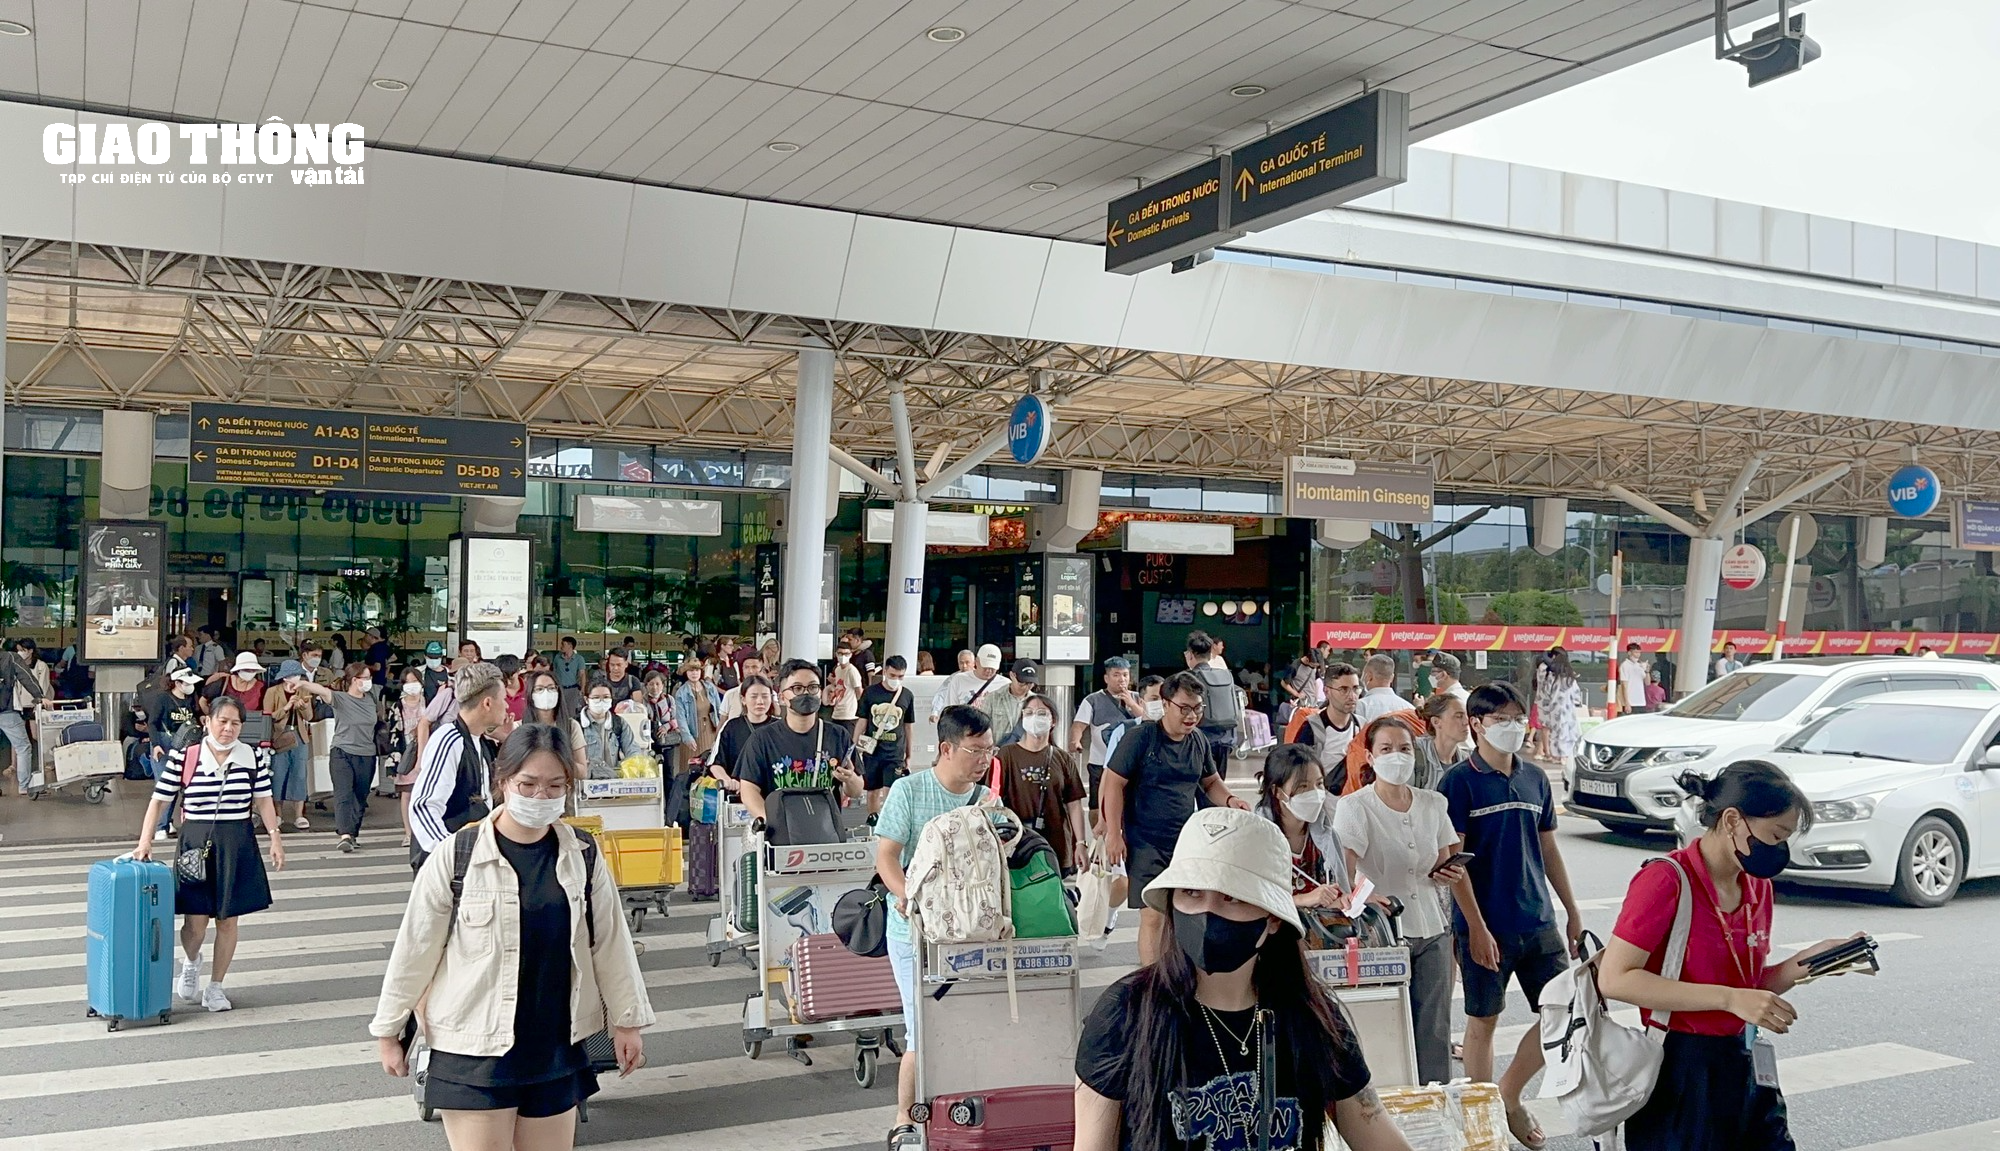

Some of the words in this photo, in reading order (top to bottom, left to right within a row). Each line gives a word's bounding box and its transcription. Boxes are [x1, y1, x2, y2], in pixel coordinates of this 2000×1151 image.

[1260, 158, 1276, 174] GA
[1278, 142, 1308, 169] QUỐC
[1311, 132, 1327, 153] TẾ
[1260, 162, 1318, 195] International
[1319, 144, 1364, 172] Terminal
[1128, 212, 1140, 226] GA
[1141, 200, 1159, 222] ĐẾN
[1160, 190, 1191, 216] TRONG
[1192, 178, 1220, 203] NƯỚC
[1127, 222, 1160, 244] Domestic
[1160, 211, 1190, 235] Arrivals
[218, 417, 230, 425] GA
[232, 416, 250, 426] ĐẾN
[253, 419, 283, 428] TRONG
[284, 420, 309, 430] NƯỚC
[383, 424, 406, 434] QUỐC
[408, 426, 419, 434] TẾ
[218, 427, 254, 436] Domestic
[255, 428, 285, 437] Arrivals
[314, 425, 360, 439] A1-A3
[1010, 422, 1028, 441] VIB
[370, 434, 415, 443] International
[416, 436, 448, 444] Terminal
[242, 449, 271, 458] TRONG
[273, 450, 297, 459] NƯỚC
[216, 458, 252, 466] Domestic
[253, 459, 296, 468] Departures
[313, 455, 359, 470] D1-D4
[393, 458, 421, 466] TRONG
[422, 458, 446, 467] NƯỚC
[369, 465, 402, 474] Domestic
[404, 467, 444, 476] Departures
[457, 464, 500, 478] D5-D8
[459, 482, 486, 490] VIETJET
[1296, 482, 1370, 503] Homtamin
[1372, 488, 1430, 510] Ginseng
[1890, 486, 1918, 502] VIB
[110, 548, 138, 556] Legend
[210, 556, 225, 564] A2
[1146, 553, 1174, 567] PURO
[344, 568, 366, 576] 10:55
[1138, 569, 1174, 585] GUSTO
[808, 850, 866, 864] DORCO
